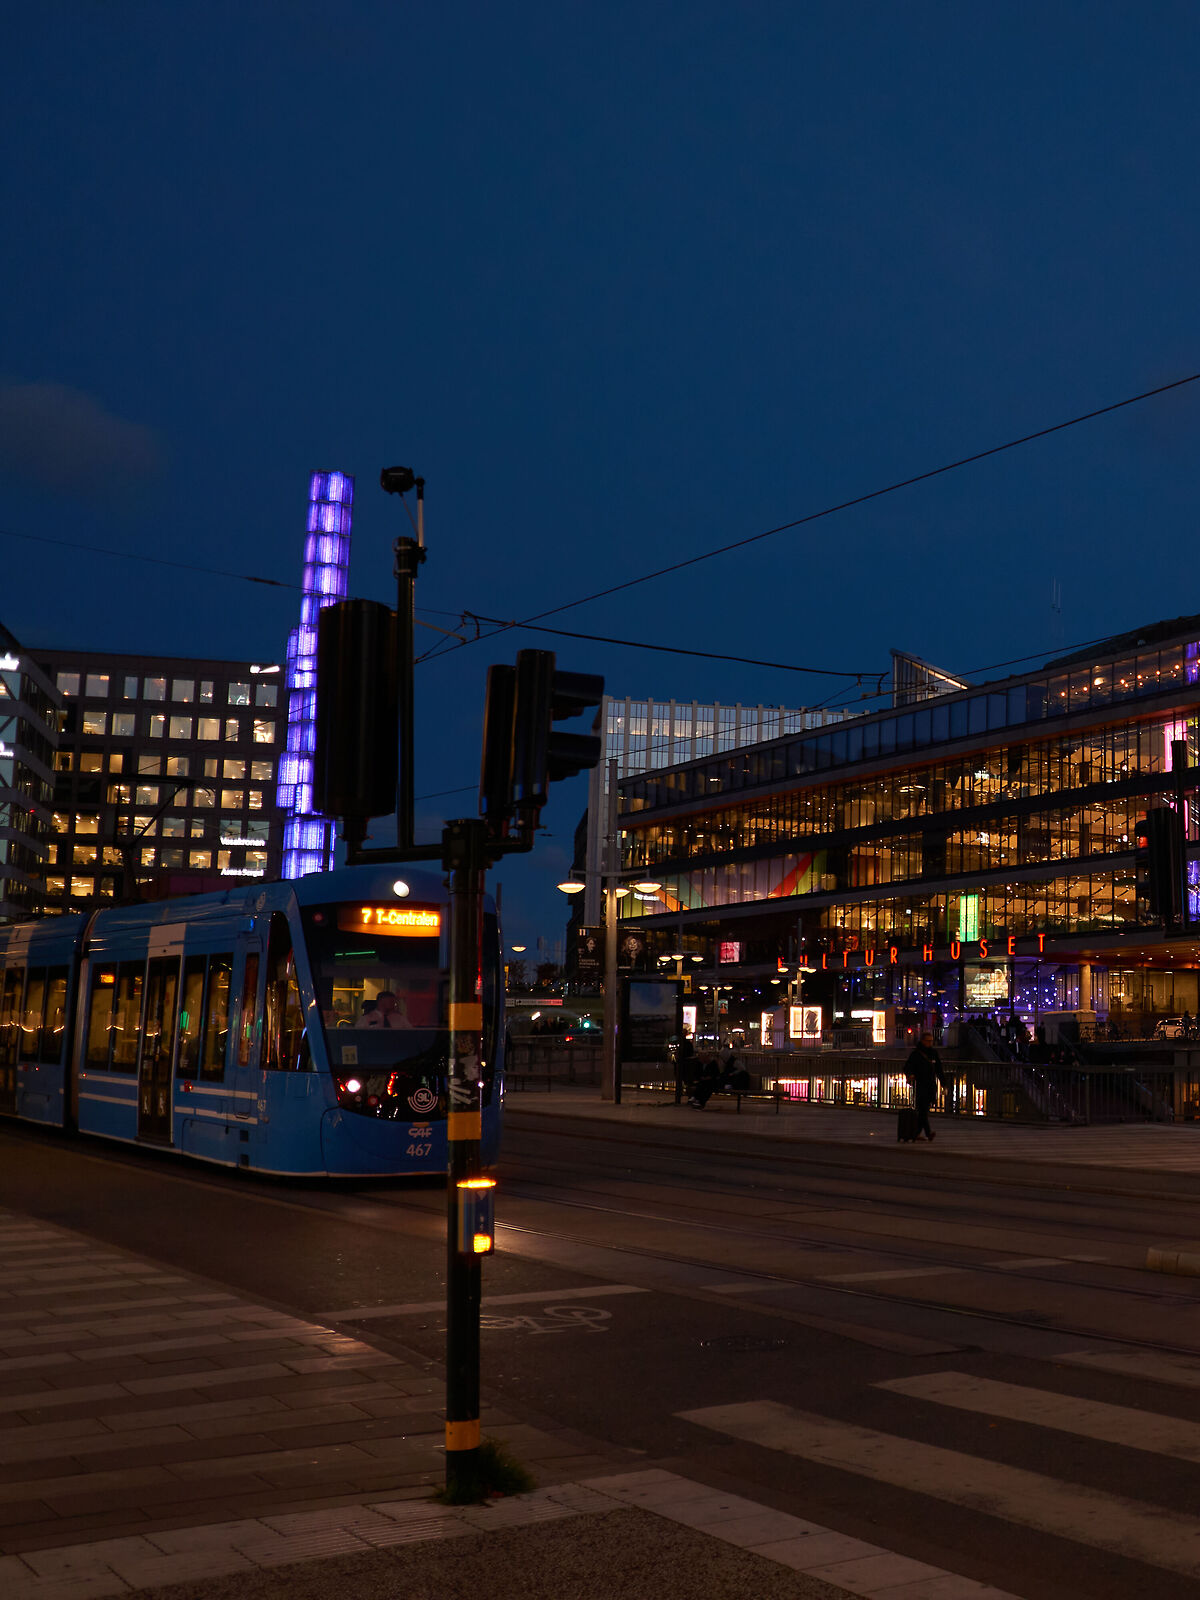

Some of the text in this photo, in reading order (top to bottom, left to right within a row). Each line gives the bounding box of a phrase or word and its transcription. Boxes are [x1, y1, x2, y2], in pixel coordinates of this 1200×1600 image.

[361, 908, 440, 927] 7 T-Centralen
[405, 1143, 432, 1157] 467
